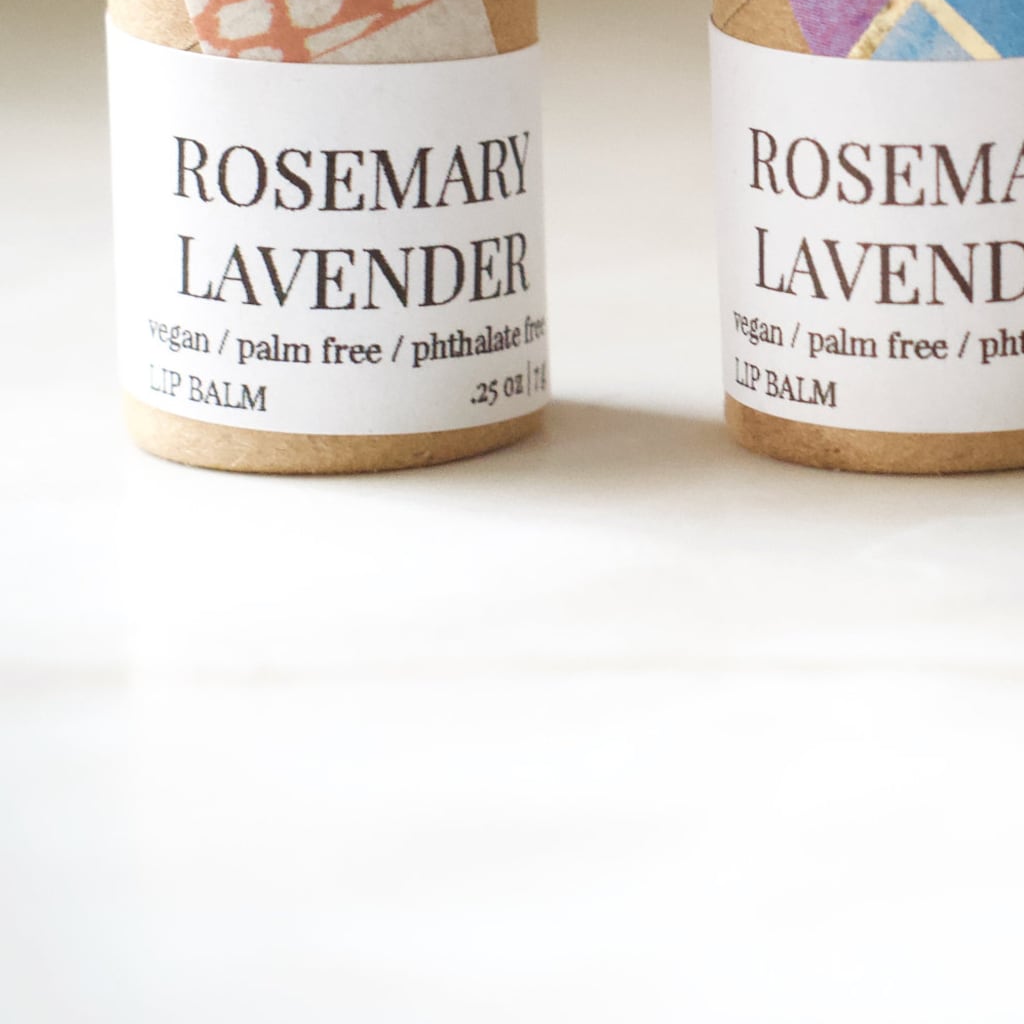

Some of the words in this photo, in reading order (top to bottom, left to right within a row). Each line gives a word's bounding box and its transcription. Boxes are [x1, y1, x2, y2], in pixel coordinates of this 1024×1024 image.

[173, 131, 530, 212] ROSEMARY
[177, 233, 530, 310] LAVENDER
[148, 319, 210, 352] vegan
[236, 333, 310, 364] palm
[322, 337, 382, 363] free
[412, 325, 521, 368] phthalate
[733, 311, 784, 346] vegan
[808, 327, 878, 358] palm
[888, 332, 948, 358] free
[149, 364, 182, 397] LIP
[188, 374, 268, 412] BALM
[470, 379, 498, 406] .25
[503, 374, 523, 397] oz
[734, 356, 761, 391] LIP
[765, 368, 837, 408] BALM
